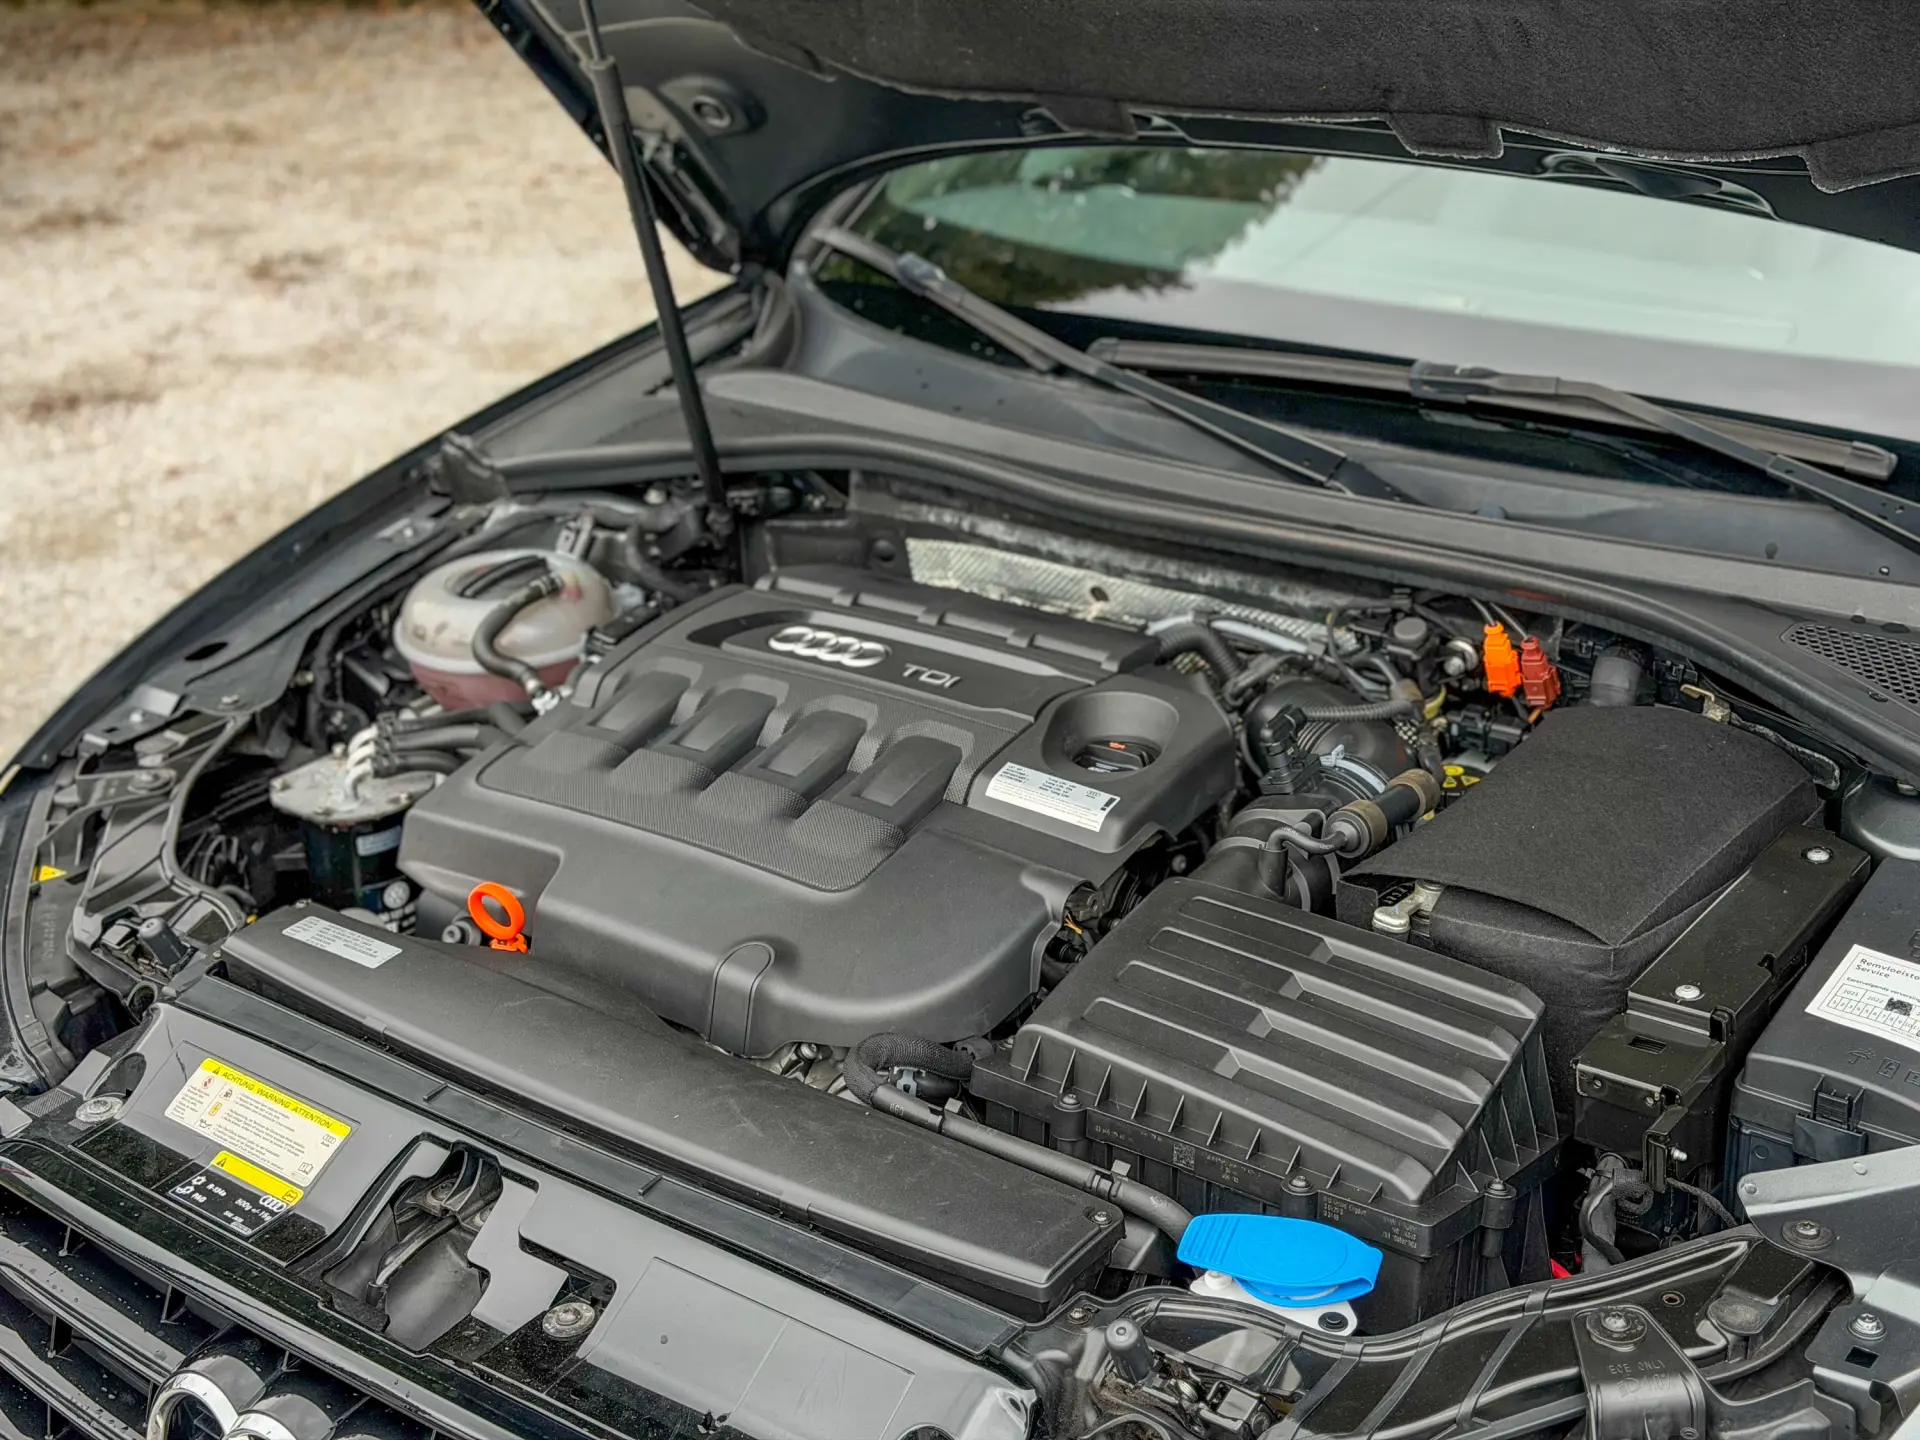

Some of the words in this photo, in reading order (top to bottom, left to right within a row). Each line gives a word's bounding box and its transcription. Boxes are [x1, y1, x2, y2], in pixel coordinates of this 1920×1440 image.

[902, 662, 961, 688] TDI
[1856, 964, 1890, 979] Service
[1846, 976, 1889, 992] Eerstvolgende
[222, 1072, 255, 1092] ACHTUNG
[257, 1088, 291, 1110] WARNING
[292, 1104, 332, 1130] ATTENTION
[234, 1198, 252, 1211] 500g
[1608, 1363, 1632, 1375] ECE
[1637, 1359, 1666, 1371] ONLY
